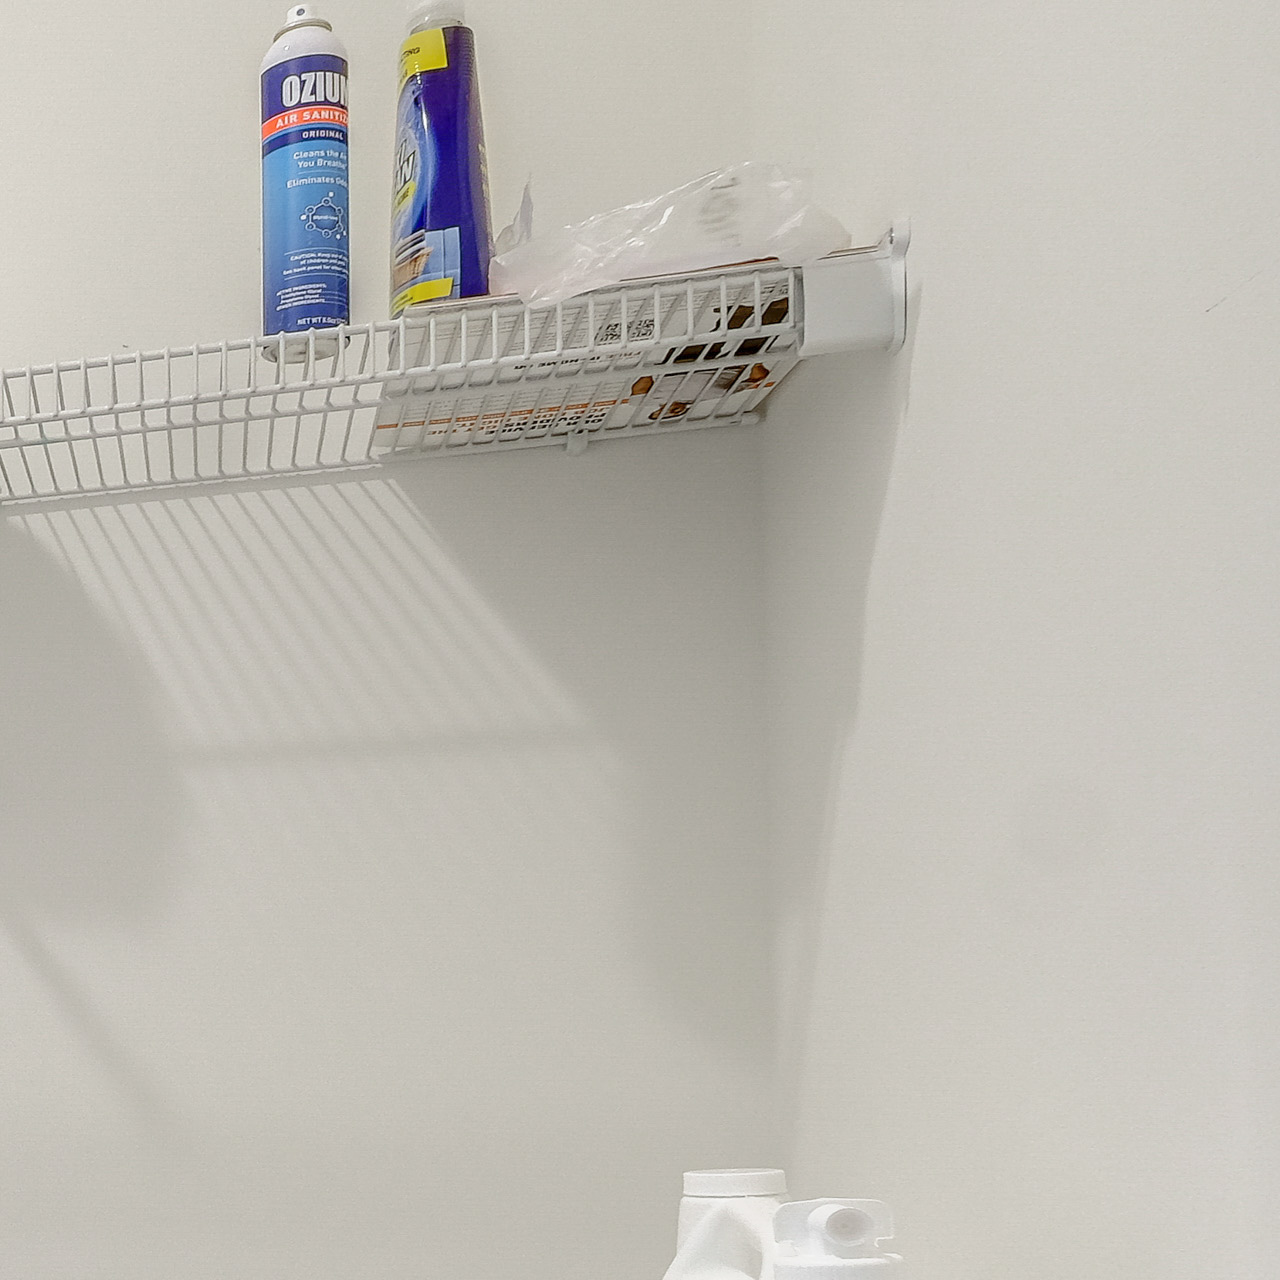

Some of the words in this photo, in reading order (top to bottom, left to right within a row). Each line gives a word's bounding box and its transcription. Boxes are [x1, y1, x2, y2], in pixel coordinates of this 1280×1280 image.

[276, 113, 298, 129] AIR
[302, 130, 344, 140] ORIGINAL
[293, 150, 325, 160] Cleans
[326, 149, 339, 158] the
[298, 161, 315, 169] You
[286, 176, 335, 189] Eliminates
